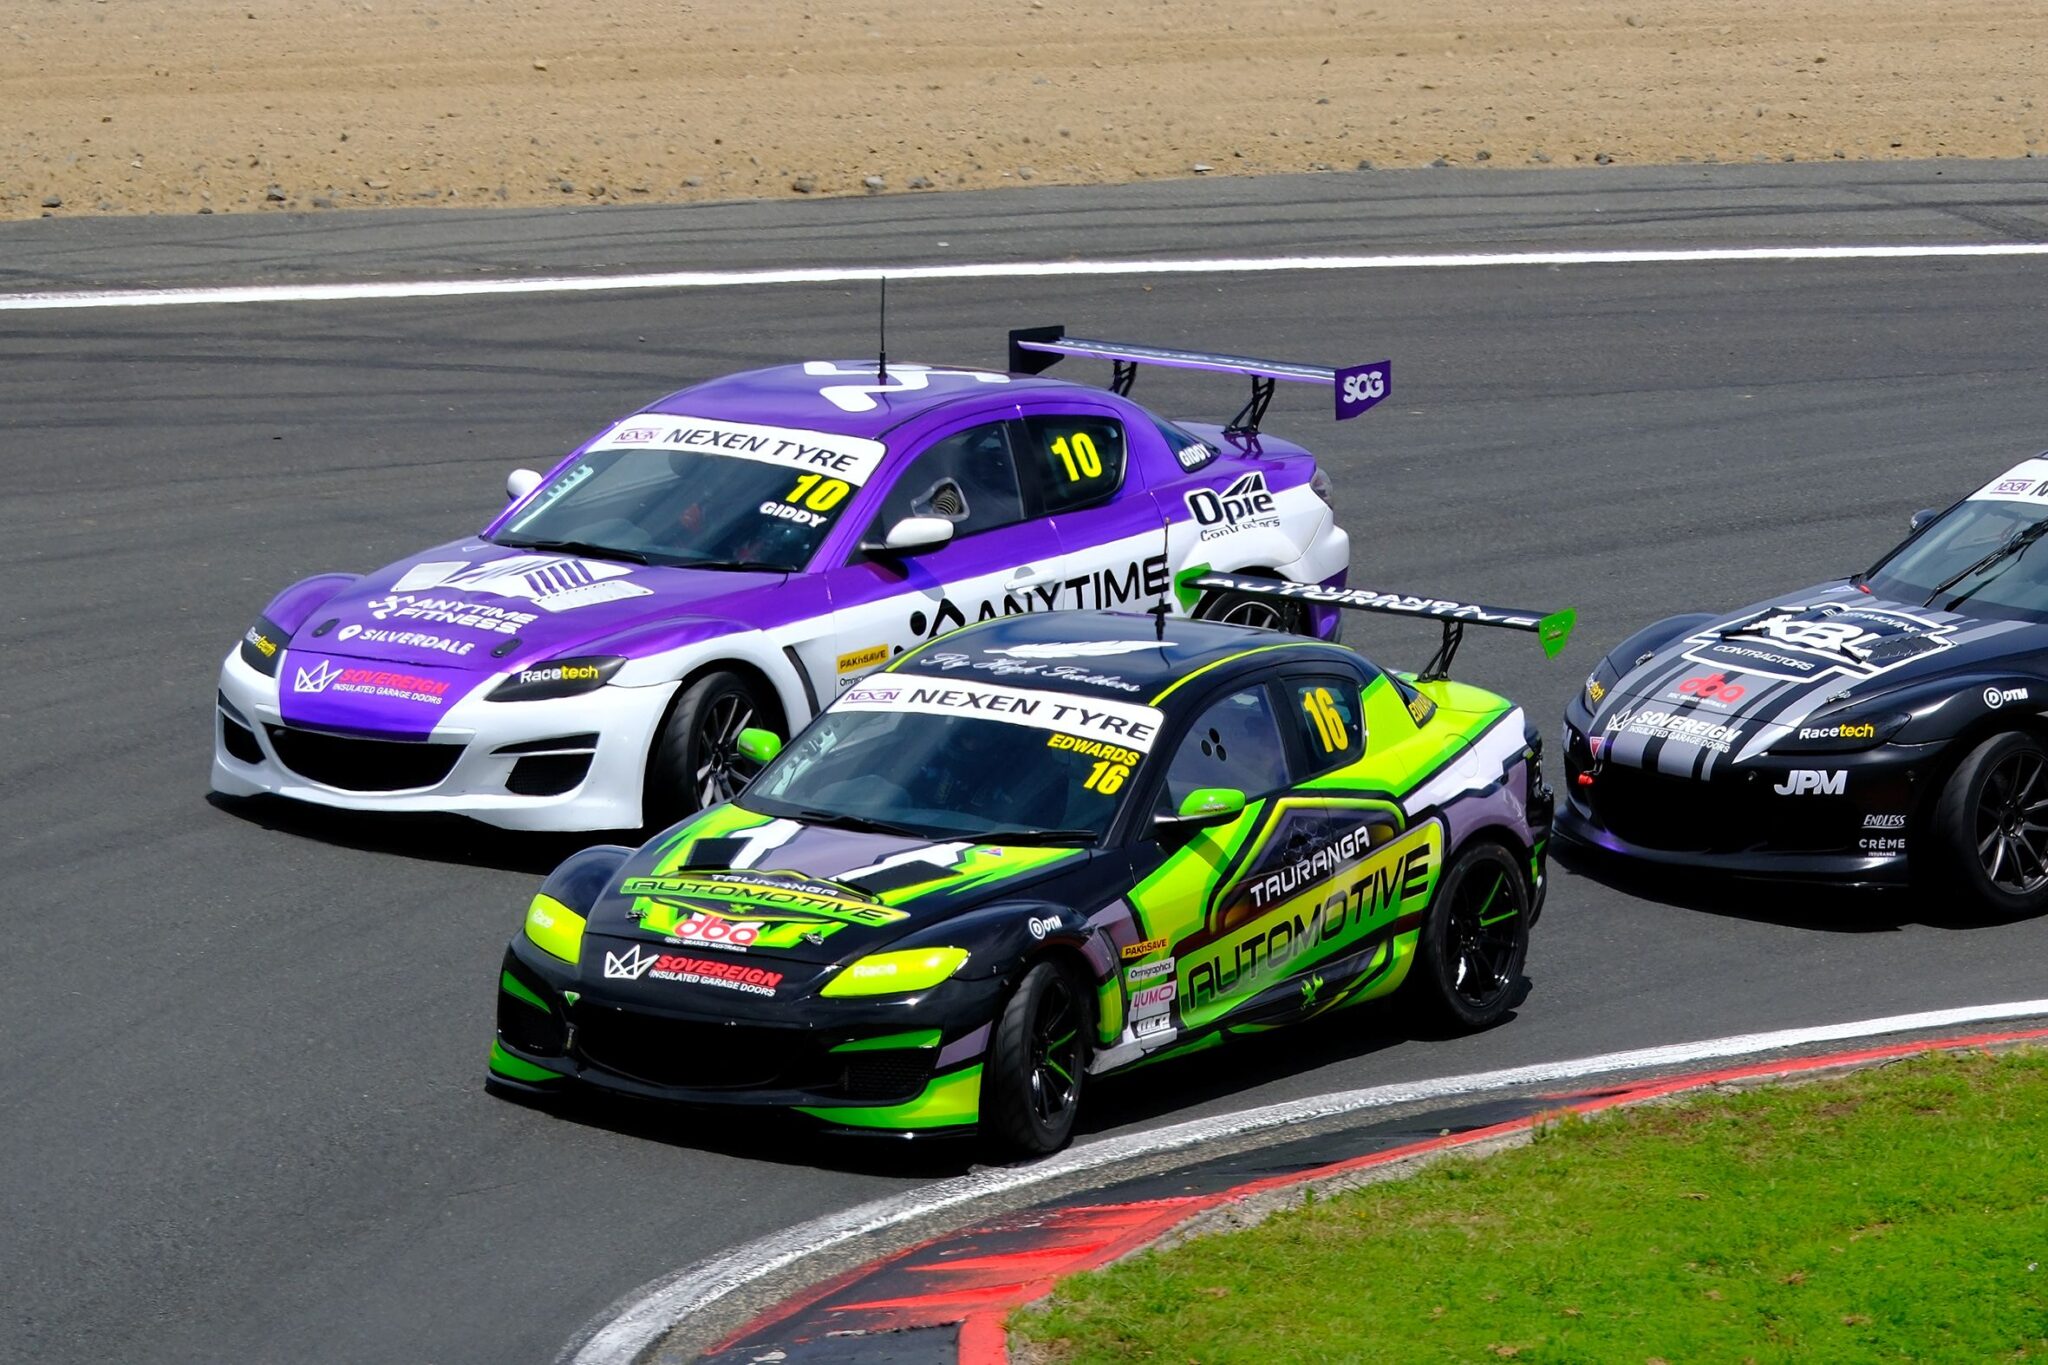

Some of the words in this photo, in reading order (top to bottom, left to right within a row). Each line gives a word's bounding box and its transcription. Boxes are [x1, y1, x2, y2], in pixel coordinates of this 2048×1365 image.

[1343, 371, 1385, 404] SCG
[615, 429, 656, 442] NEXEN
[664, 428, 769, 453] NEXEN
[772, 439, 860, 473] TYRE
[1051, 432, 1102, 483] 10
[1179, 443, 1211, 467] GIDDY
[785, 473, 851, 512] 10
[759, 501, 828, 528] GIDDY
[1187, 489, 1276, 526] Opie
[409, 597, 539, 625] ANYTIME
[1202, 578, 1541, 627] AUTOMOTIVE
[394, 607, 522, 635] FITNESS
[359, 629, 476, 656] SILVERDALE
[1712, 644, 1816, 672] CONTRACTORS
[339, 668, 451, 695] SOVEREIGN
[520, 664, 600, 684] Racetech
[332, 683, 376, 696] INSULATED
[376, 686, 411, 701] GARAGE
[411, 692, 444, 706] DOORS
[845, 690, 901, 703] NEXEN
[2002, 687, 2029, 702] DTM
[908, 688, 1042, 716] NEXEN
[1051, 703, 1157, 742] TYRE
[1303, 687, 1349, 753] 16
[1635, 710, 1743, 743] SOVEREIGN
[1627, 725, 1669, 739] INSULATED
[1668, 731, 1700, 746] GARAGE
[1700, 738, 1731, 753] DOORS
[1799, 723, 1874, 741] Racetech
[1046, 733, 1141, 767] EDWARDS
[1083, 760, 1131, 796] 16
[1773, 770, 1848, 796] JPM
[1863, 814, 1907, 826] ENDLESS
[1858, 837, 1906, 849] CRÈME
[1250, 825, 1372, 908] TAURANGA
[711, 873, 839, 897] TAURANGA
[631, 880, 891, 921] AUTOMOTIVE
[674, 912, 759, 946] dba
[1043, 915, 1063, 931] DTM
[1186, 842, 1432, 1010] AUTOMOTIVE
[649, 968, 700, 985] INSULATED
[700, 973, 740, 991] GARAGE
[740, 982, 777, 998] DOORS
[654, 954, 784, 988] SOVEREIGN
[1130, 962, 1172, 979] Omnigraphics
[1133, 985, 1174, 1008] LUMO
